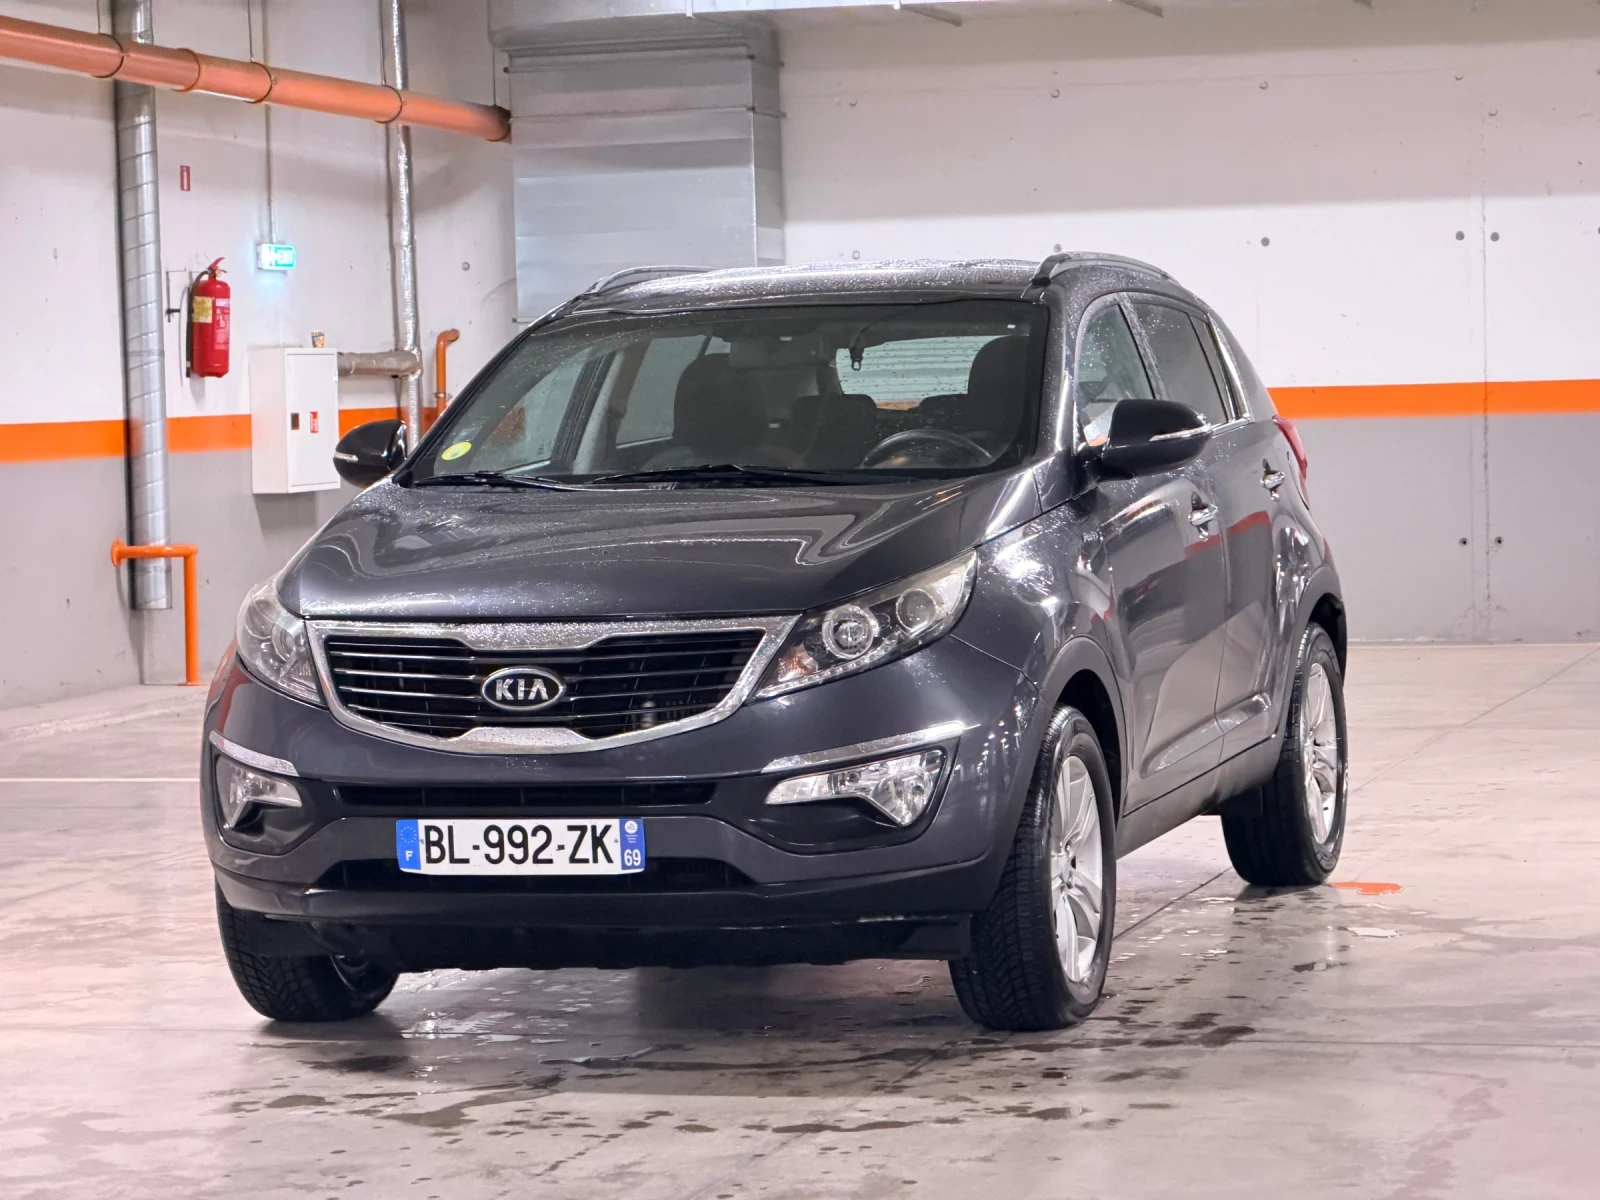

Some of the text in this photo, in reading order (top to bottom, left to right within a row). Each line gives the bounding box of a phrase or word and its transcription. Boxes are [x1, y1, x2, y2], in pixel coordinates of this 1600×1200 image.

[495, 678, 549, 700] KIA
[424, 825, 614, 865] BL-992-ZK
[405, 850, 413, 861] F
[624, 849, 641, 866] 69
